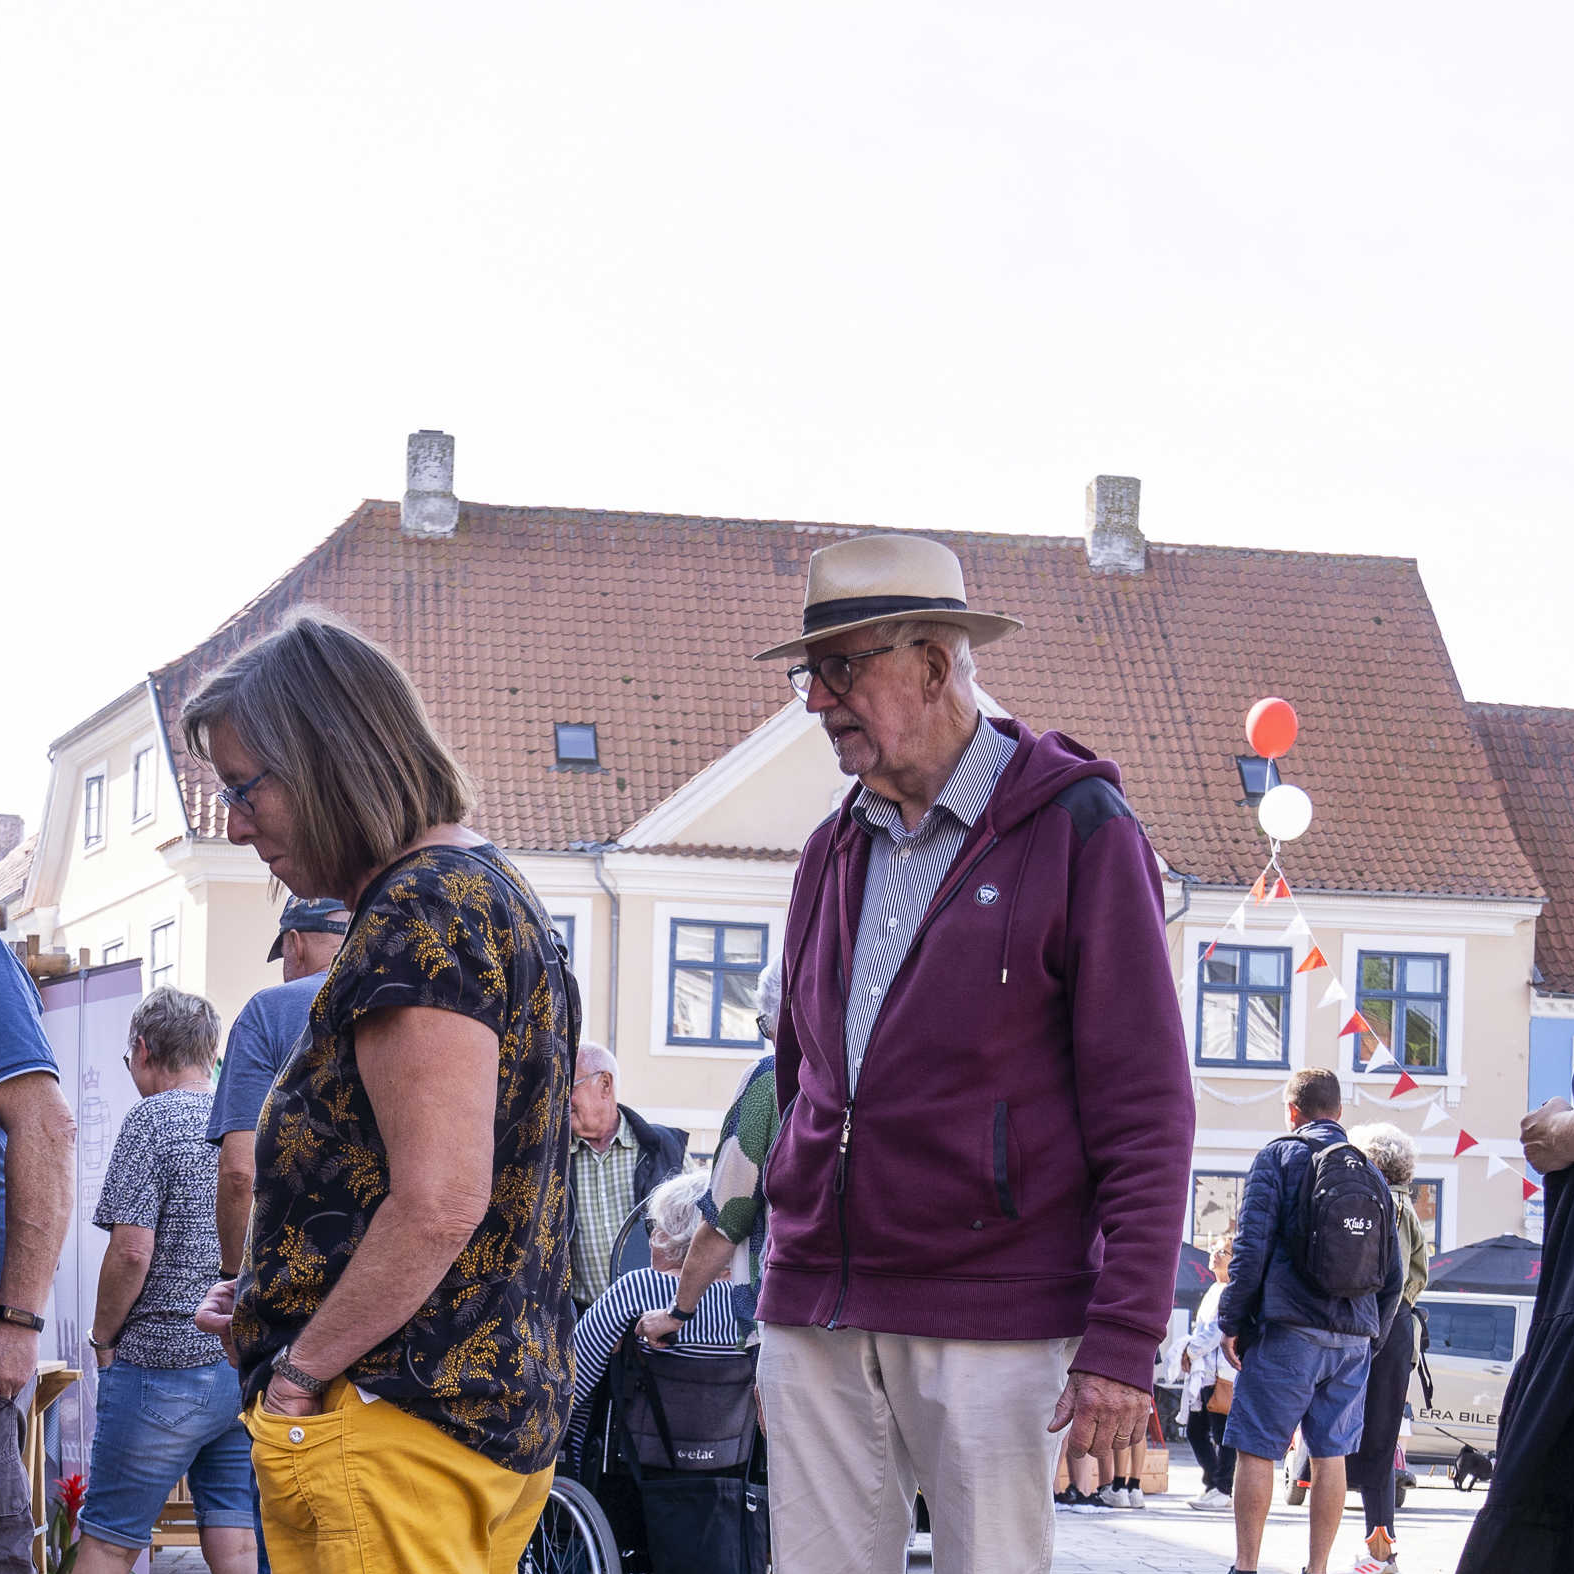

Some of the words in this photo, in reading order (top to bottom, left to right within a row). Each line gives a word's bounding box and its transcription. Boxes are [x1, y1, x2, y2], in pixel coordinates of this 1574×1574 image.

[1343, 1217, 1365, 1230] Klub
[1365, 1219, 1373, 1230] 3
[1419, 1408, 1454, 1421] ERA
[1459, 1410, 1499, 1425] BILE
[687, 1449, 715, 1460] etac
